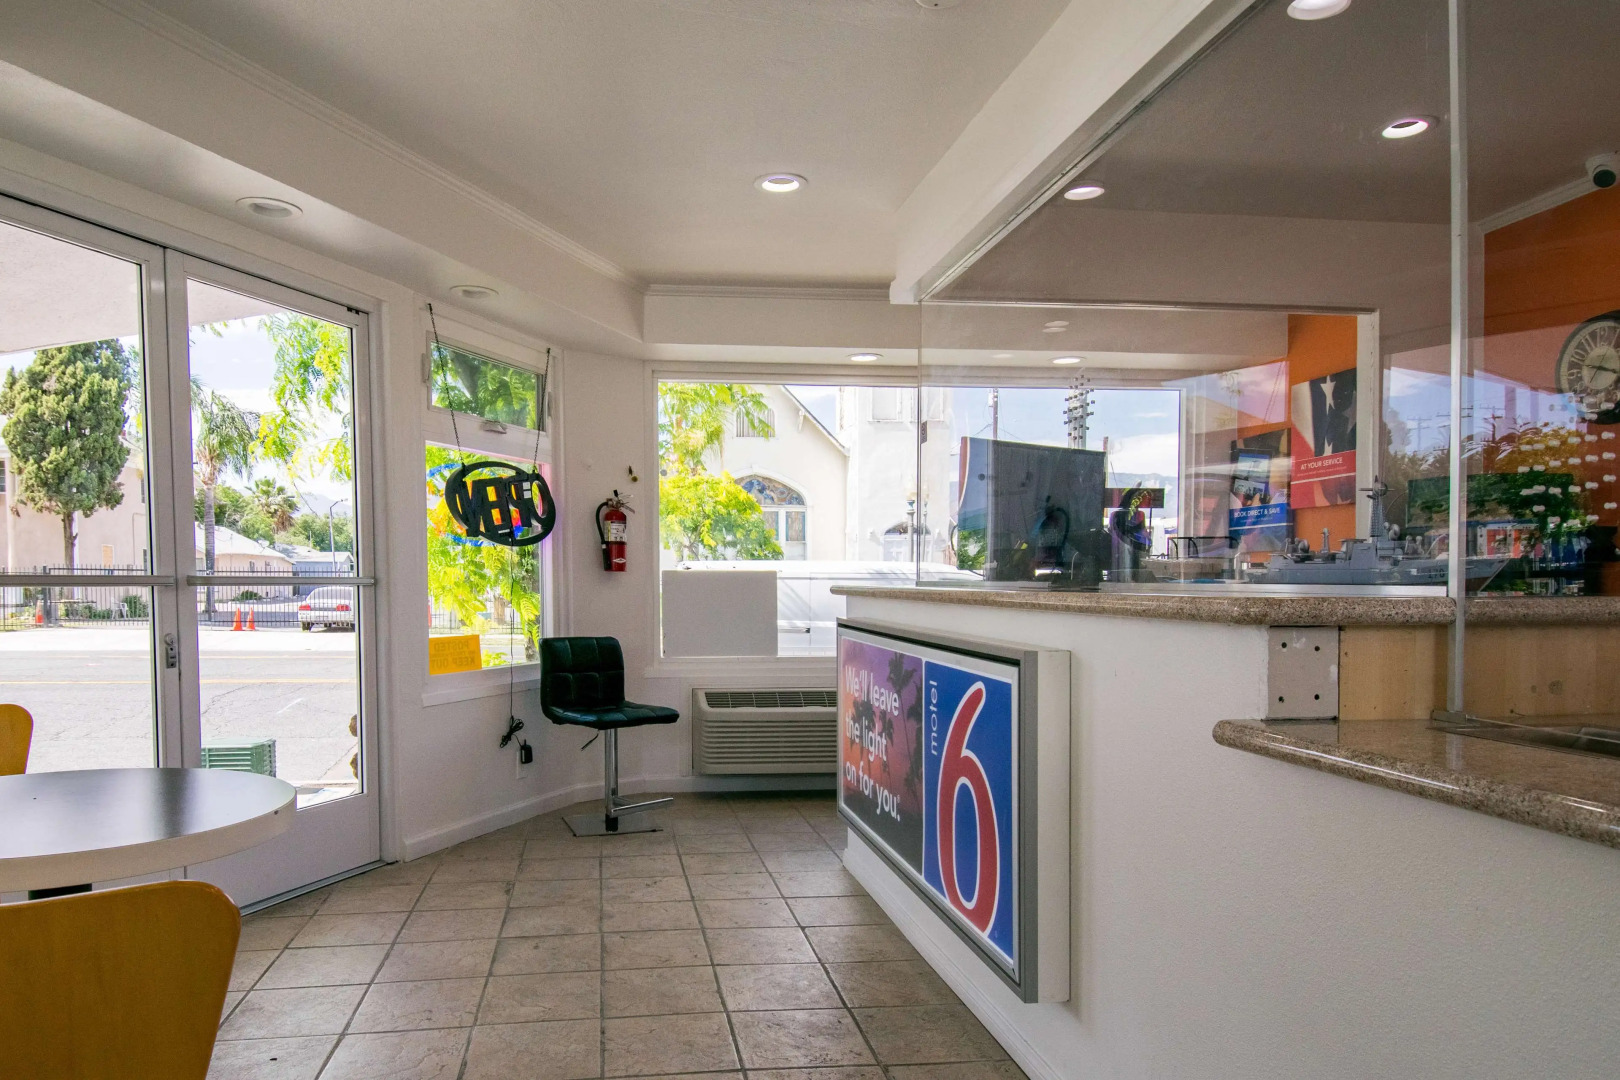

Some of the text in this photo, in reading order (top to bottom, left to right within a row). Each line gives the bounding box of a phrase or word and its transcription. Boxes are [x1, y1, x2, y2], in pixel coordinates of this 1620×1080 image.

[1595, 326, 1609, 348] 12
[1570, 348, 1587, 365] 10
[1308, 460, 1322, 469] YOUR
[1322, 456, 1343, 467] SERVICE
[1234, 506, 1281, 518] BOOK DIRECT & SAVE
[845, 664, 899, 716] We'll leave
[845, 709, 887, 762] the light
[845, 760, 857, 787] on
[858, 761, 874, 799] for
[929, 680, 1000, 938] motel 6
